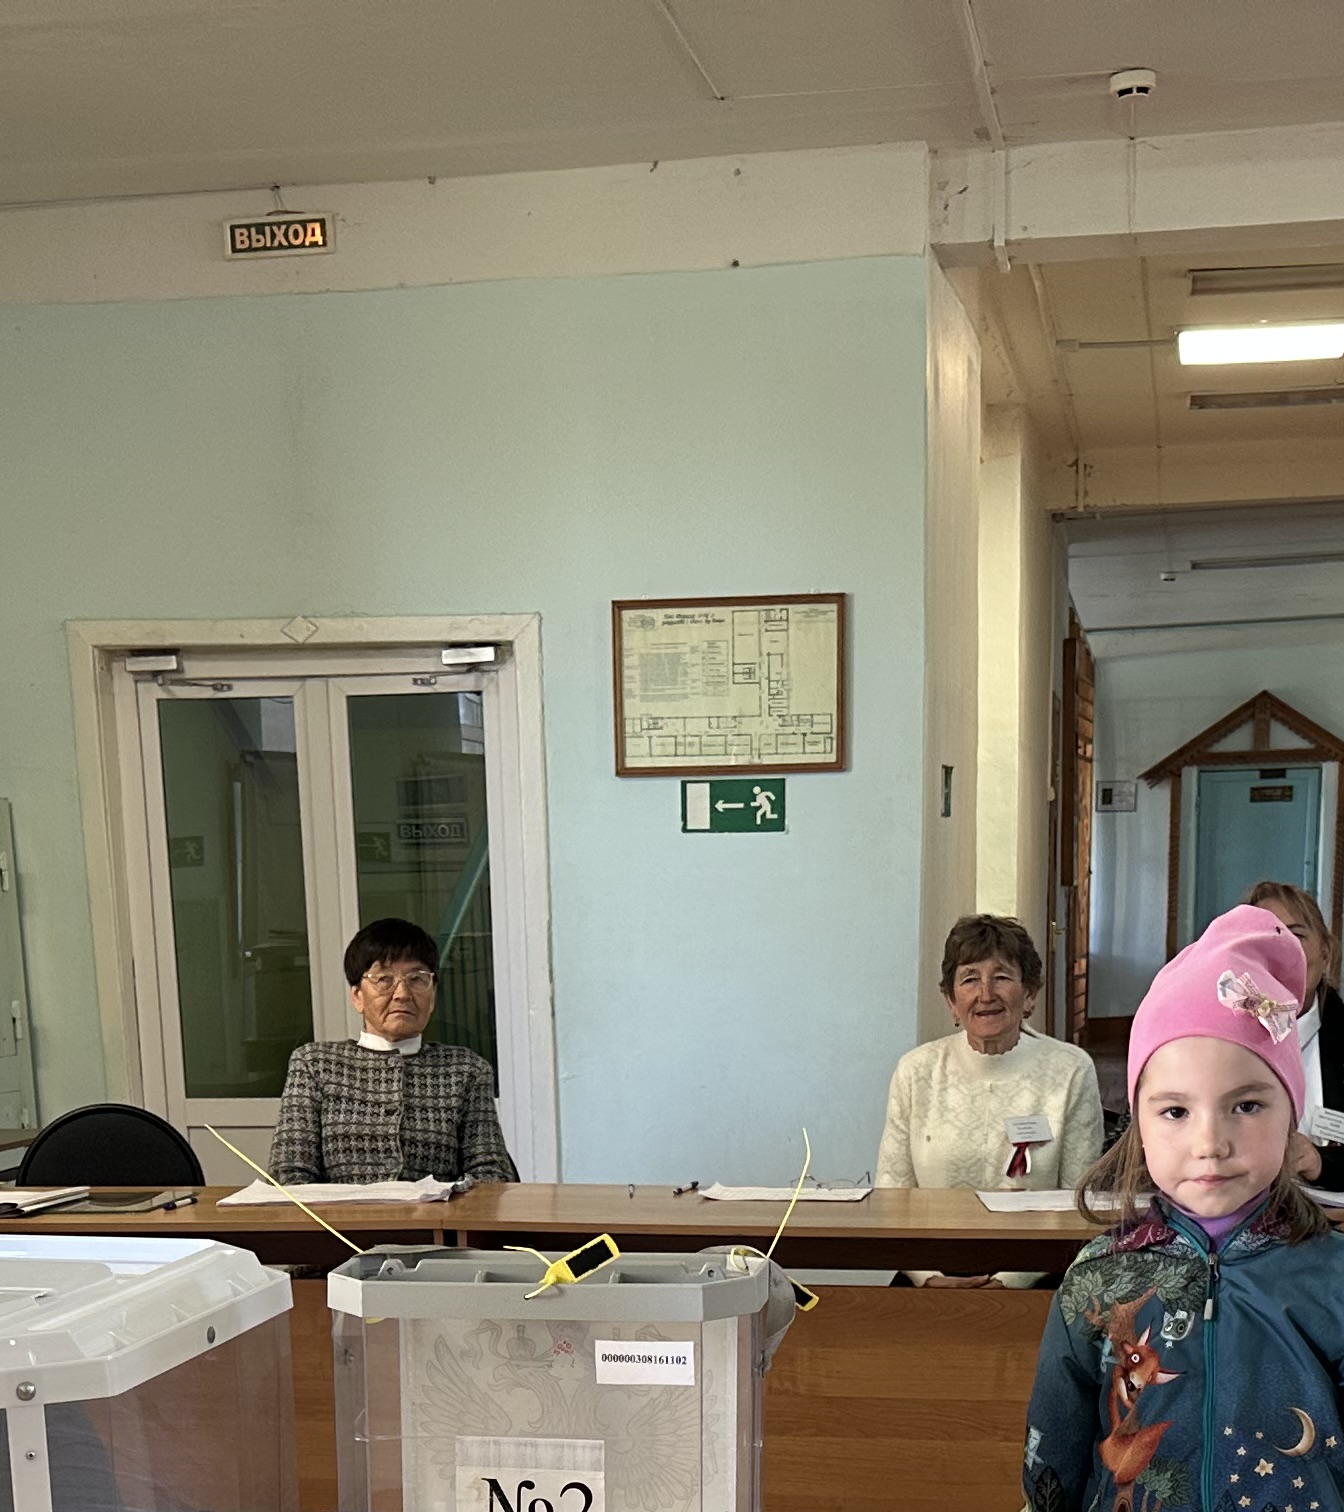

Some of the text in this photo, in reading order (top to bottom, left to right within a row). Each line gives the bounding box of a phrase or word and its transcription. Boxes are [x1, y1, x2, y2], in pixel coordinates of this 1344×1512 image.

[234, 222, 324, 250] ВЫХОД
[399, 824, 462, 839] ВЫХОД
[601, 1353, 688, 1366] 000000308161102
